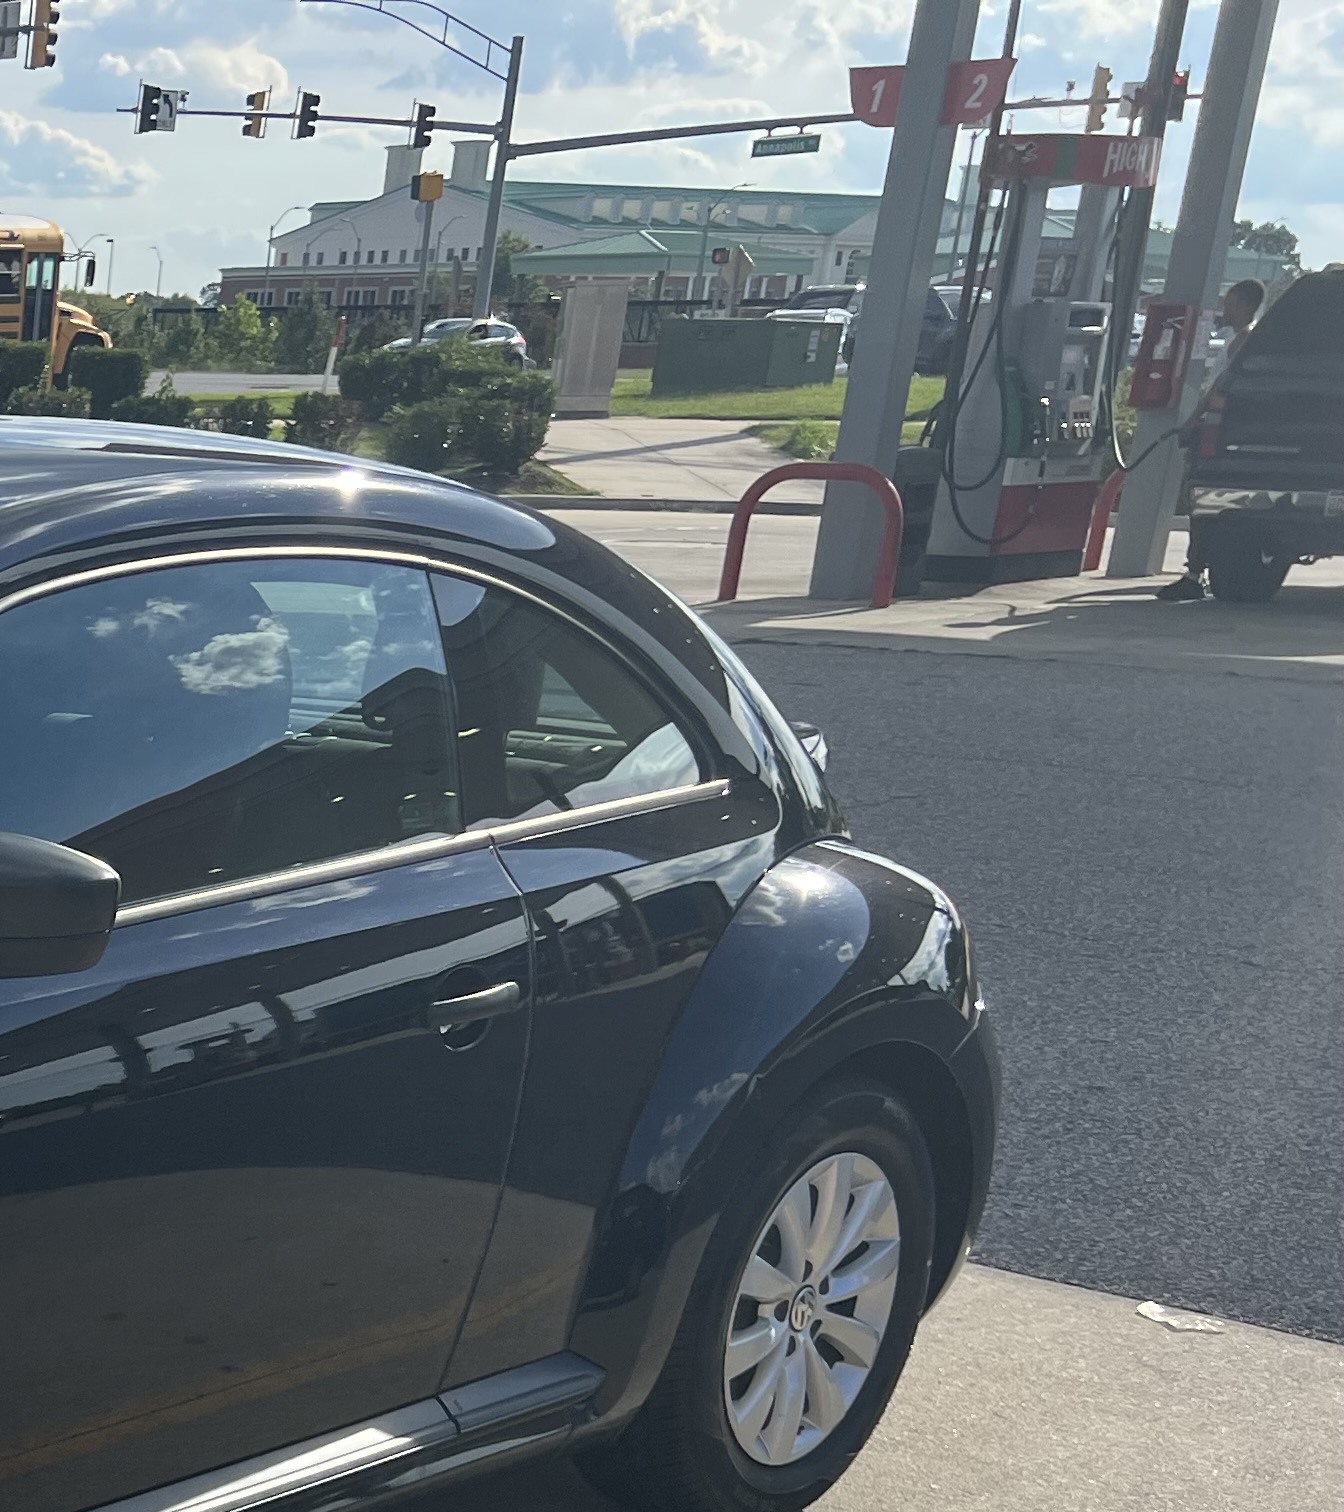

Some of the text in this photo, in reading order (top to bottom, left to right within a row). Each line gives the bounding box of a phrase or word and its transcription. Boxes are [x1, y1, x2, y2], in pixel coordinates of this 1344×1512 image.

[870, 79, 886, 113] 1
[964, 73, 989, 109] 2
[756, 139, 805, 155] Annapolis
